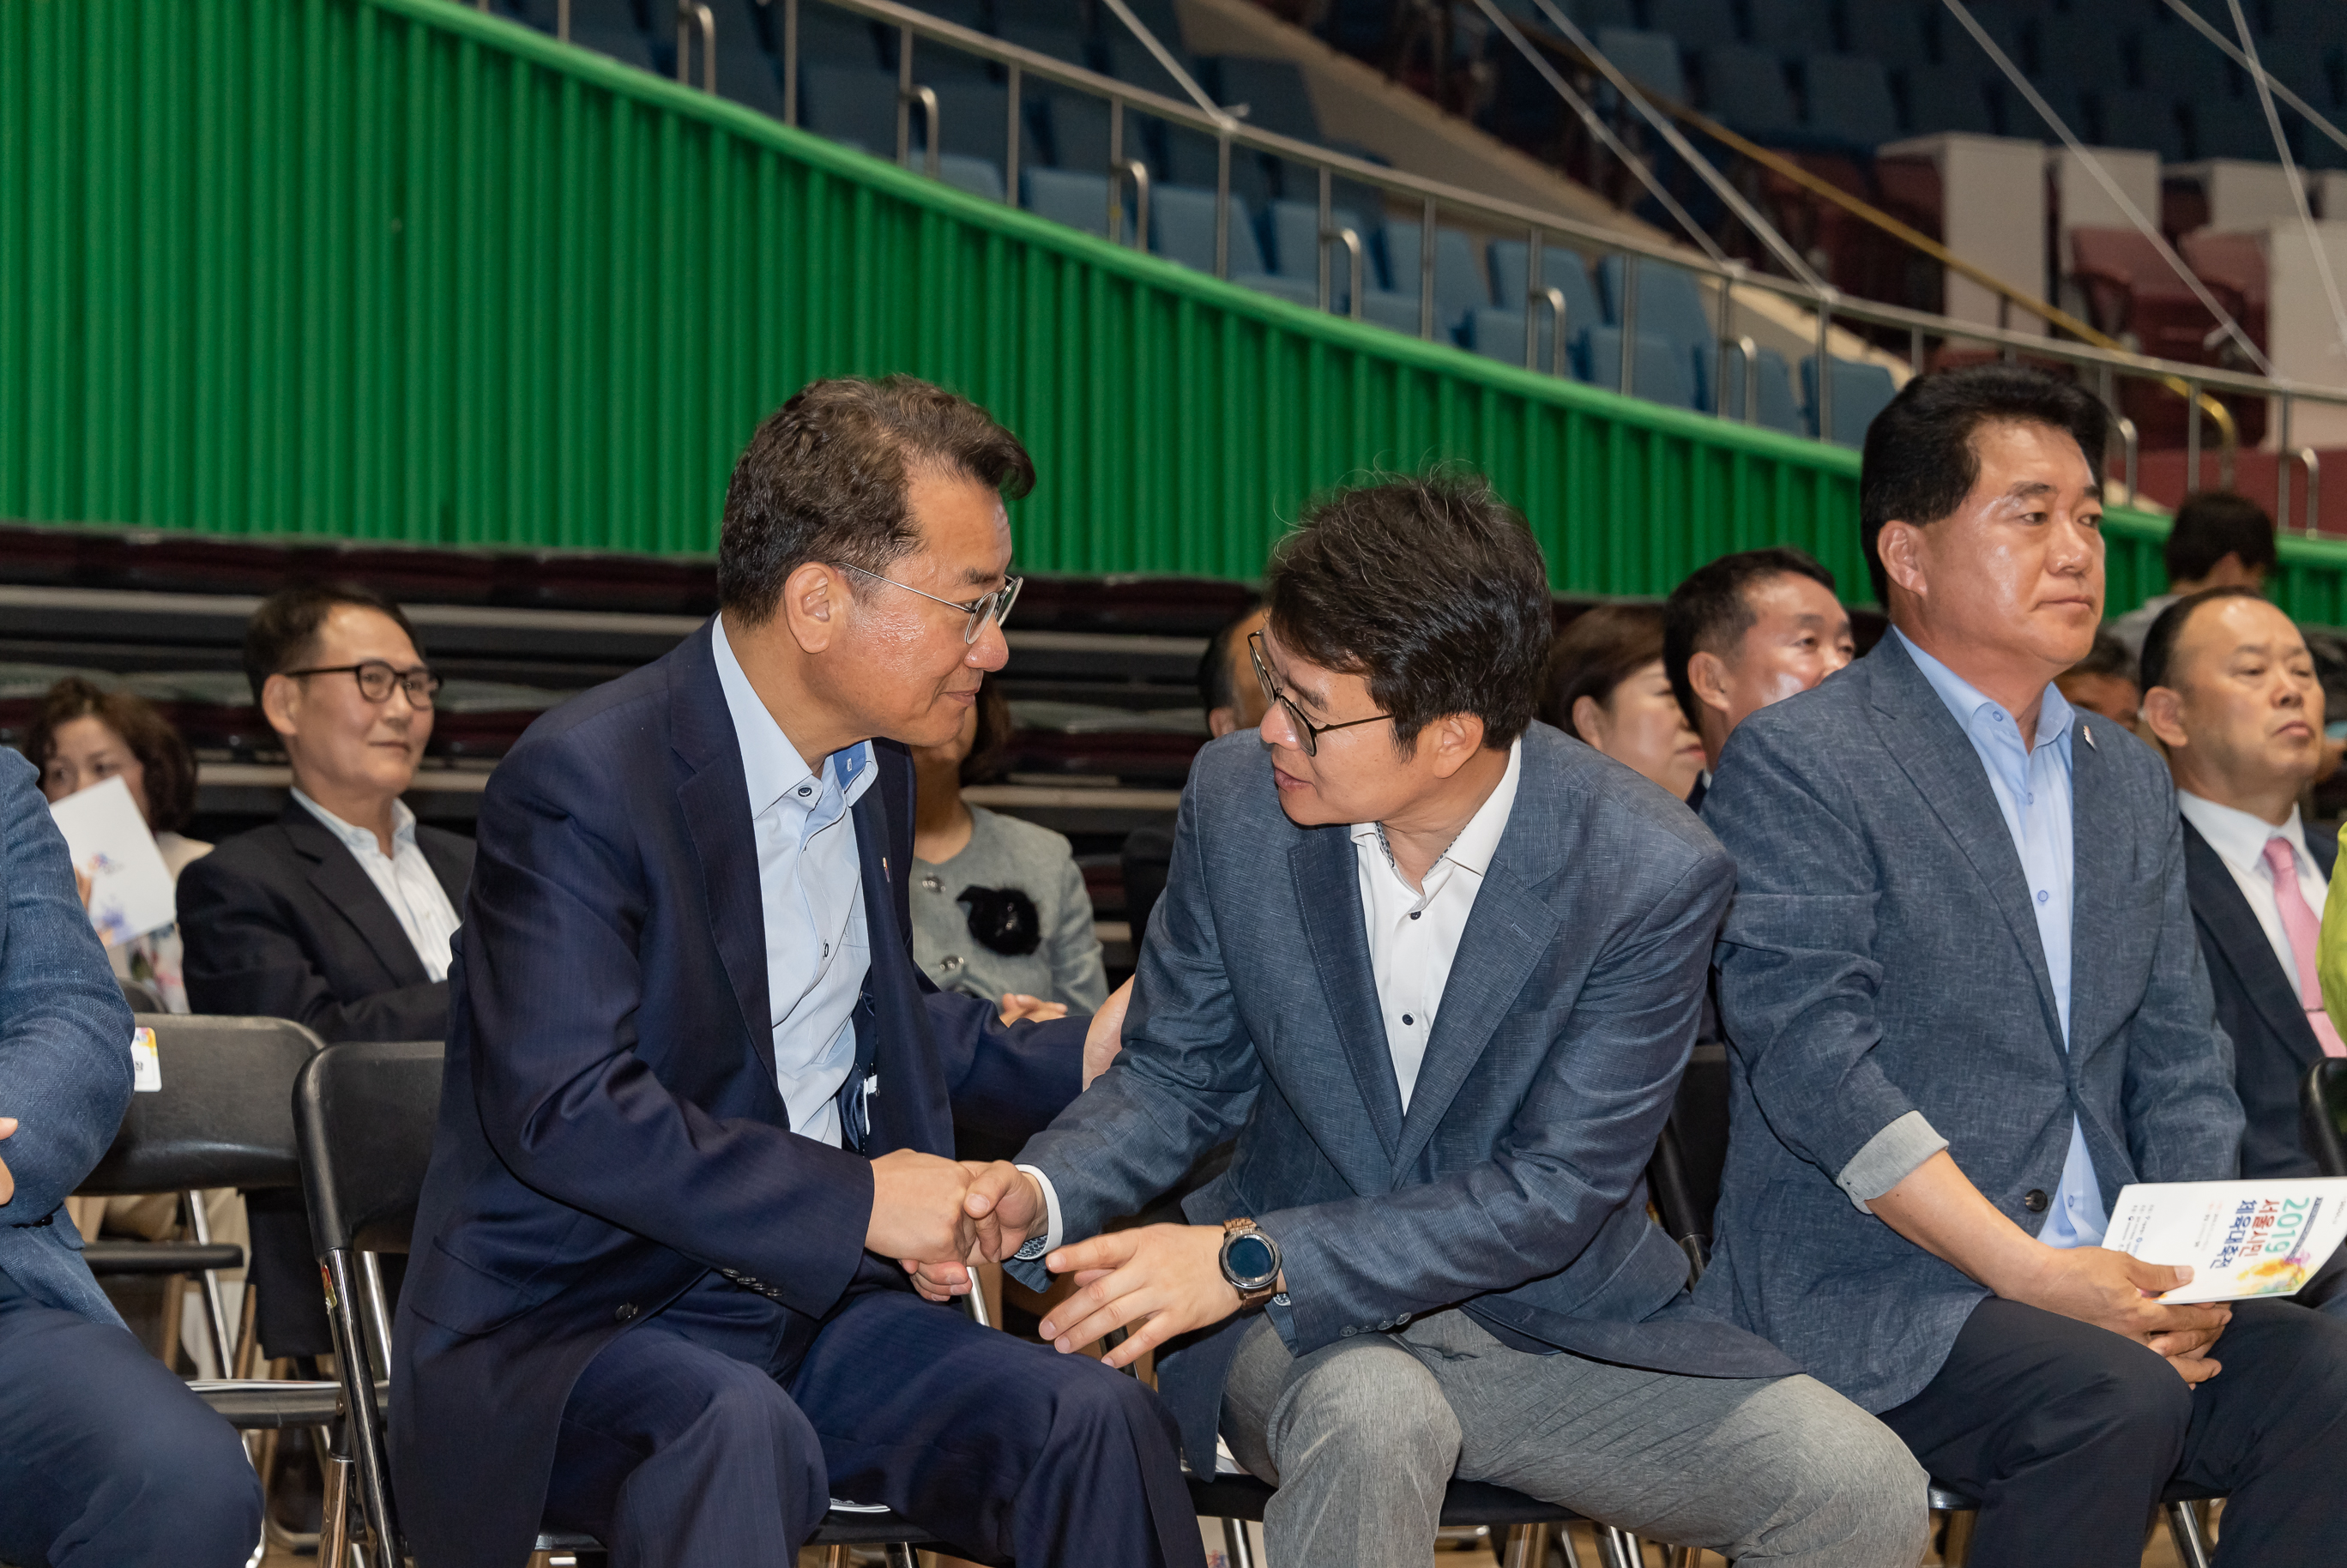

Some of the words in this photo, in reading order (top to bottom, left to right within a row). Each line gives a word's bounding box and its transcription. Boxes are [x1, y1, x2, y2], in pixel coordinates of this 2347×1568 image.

[2210, 1200, 2257, 1269] 체육대축전
[2238, 1199, 2280, 1257] 서울시민
[2265, 1197, 2309, 1252] 2019
